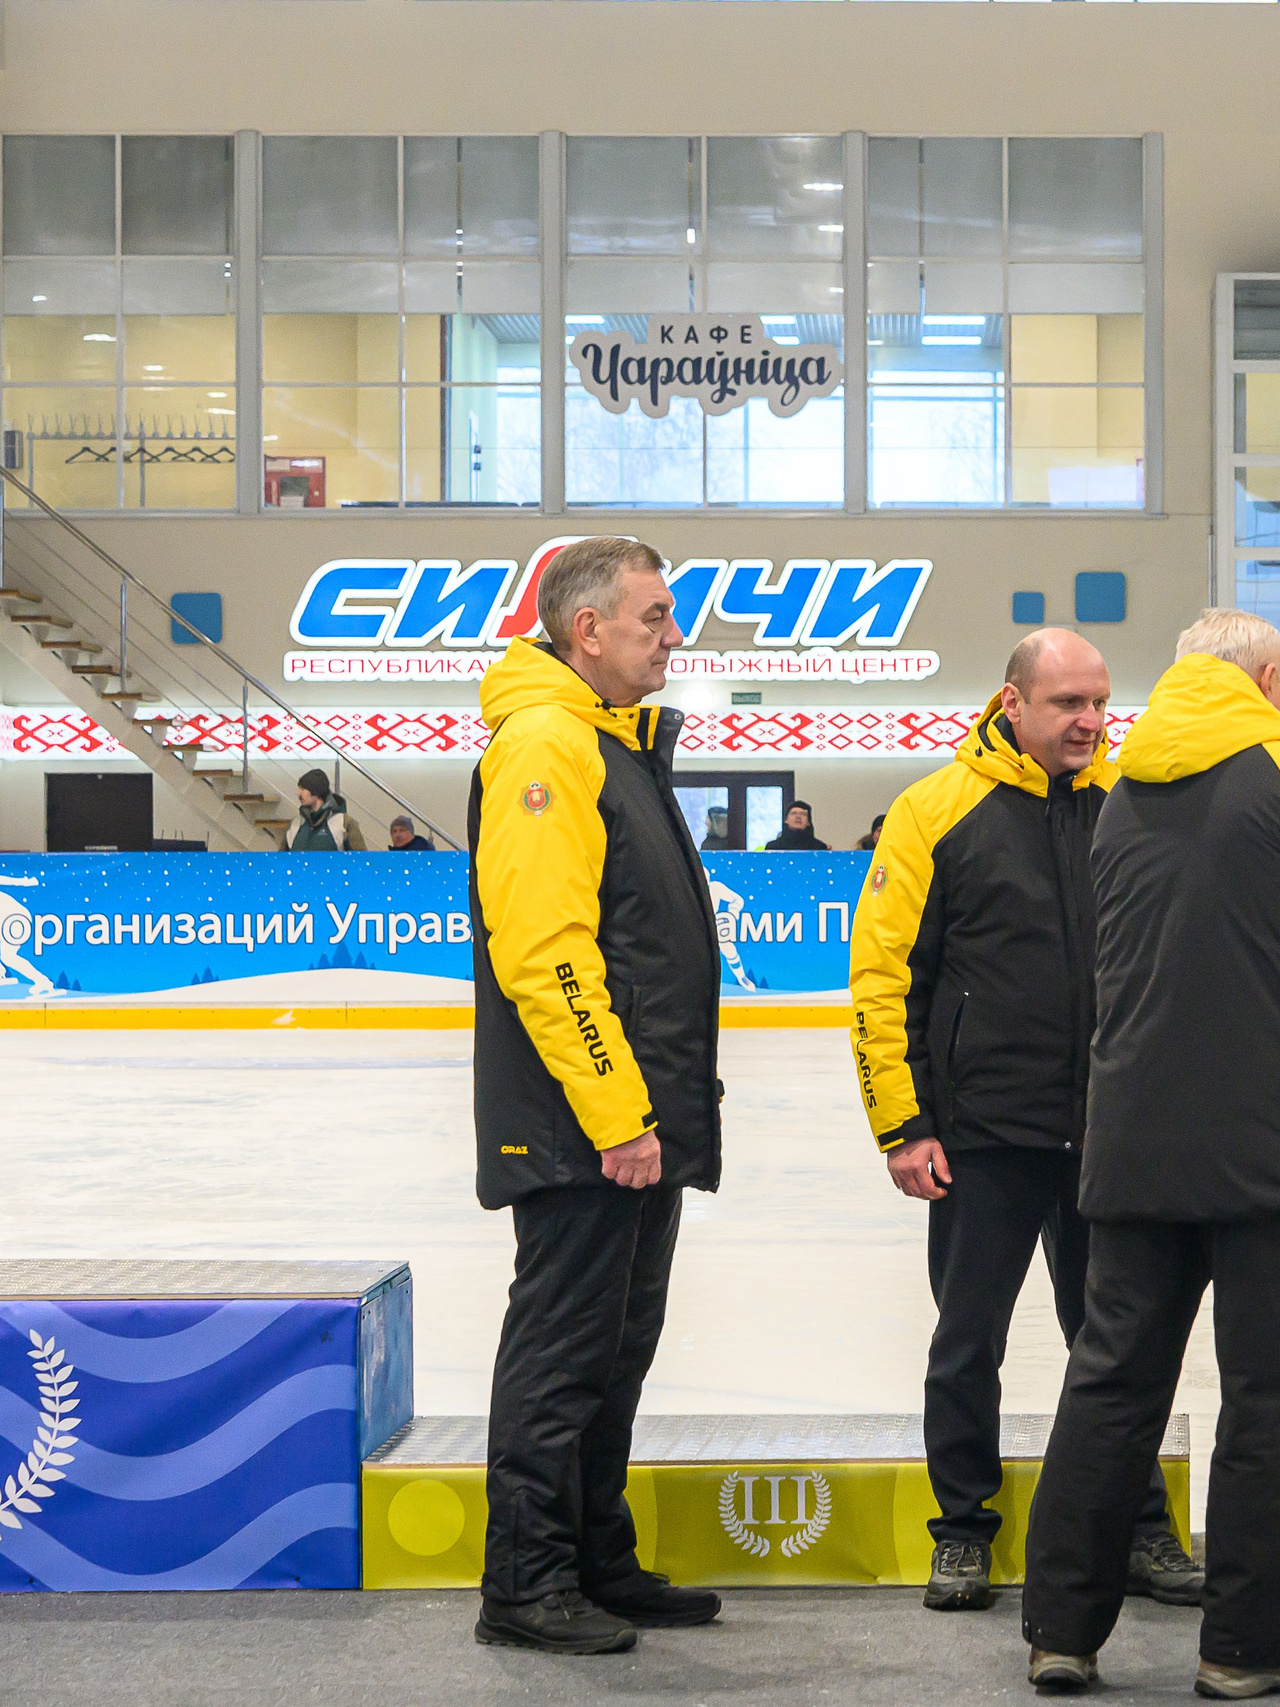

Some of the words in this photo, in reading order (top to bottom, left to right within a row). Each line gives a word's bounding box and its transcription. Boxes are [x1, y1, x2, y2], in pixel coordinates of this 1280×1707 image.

[660, 324, 753, 344] КАФЕ
[581, 343, 832, 407] Чараўніца
[291, 658, 491, 673] РЕСПУБЛИКА
[665, 654, 832, 673] ОЛЫЖНЫЙ
[841, 658, 932, 676] ЦЕНТР
[1, 903, 314, 955] организаций
[327, 902, 474, 955] Управ
[715, 911, 803, 943] ами
[817, 901, 850, 943] П
[555, 961, 614, 1077] BELARUS
